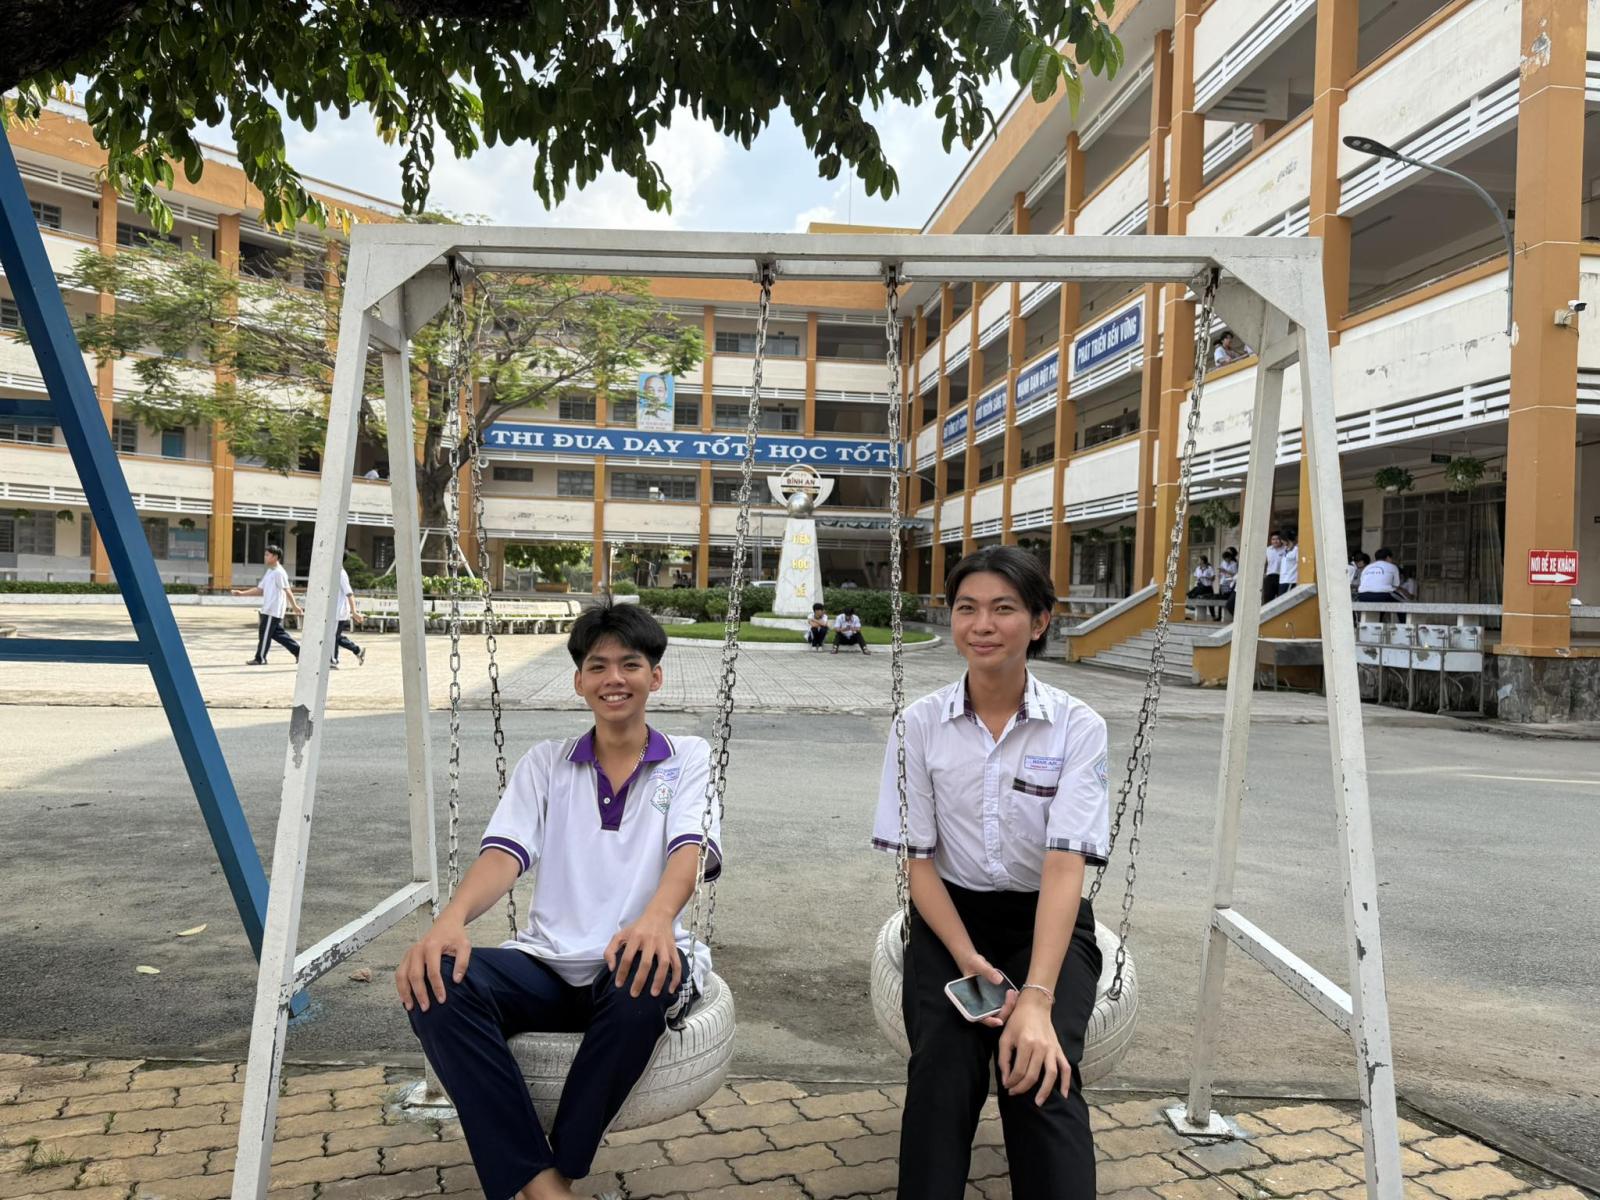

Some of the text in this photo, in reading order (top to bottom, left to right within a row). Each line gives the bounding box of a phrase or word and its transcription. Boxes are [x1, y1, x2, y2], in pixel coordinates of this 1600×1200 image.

[1078, 341, 1090, 366] PHÁT
[491, 430, 544, 447] THI
[552, 433, 615, 450] ĐUA
[623, 437, 684, 456] DẠY
[693, 436, 750, 457] TỐT
[768, 444, 827, 463] HỌC
[836, 443, 890, 463] TỐT
[1550, 557, 1557, 572] XE
[1558, 555, 1576, 573] KHÁCH
